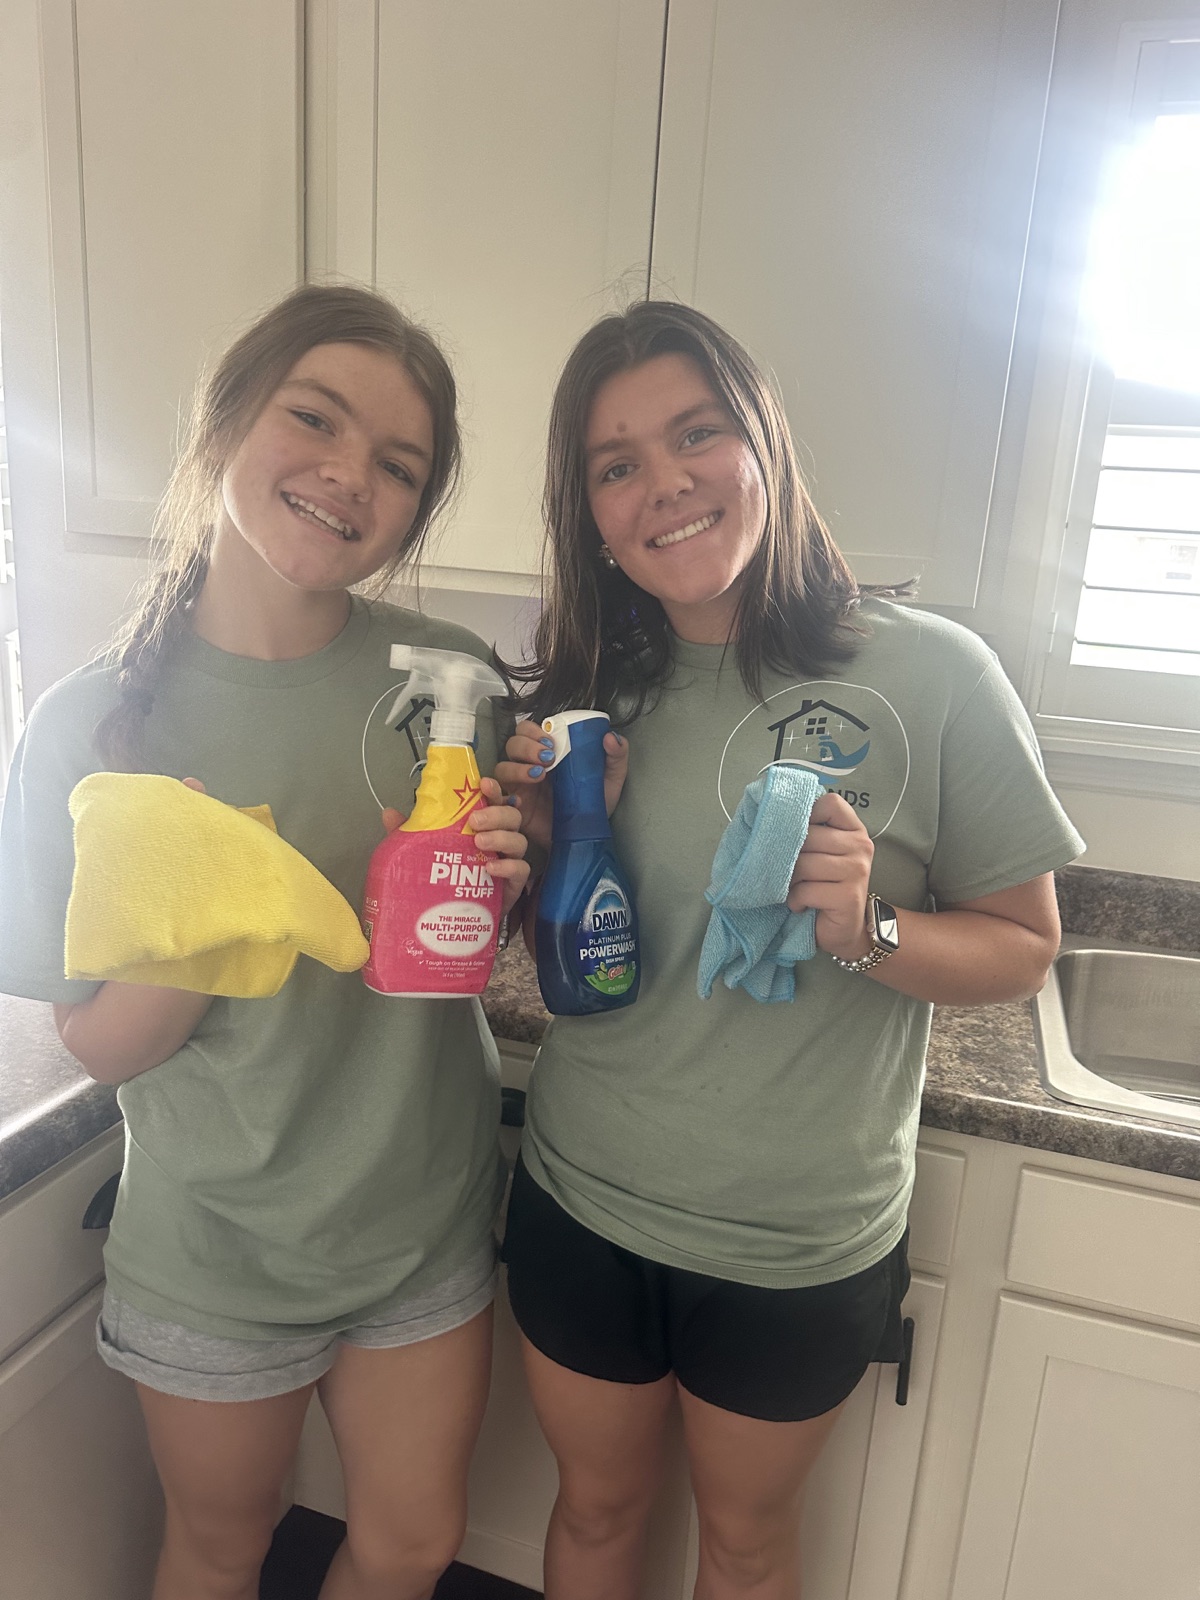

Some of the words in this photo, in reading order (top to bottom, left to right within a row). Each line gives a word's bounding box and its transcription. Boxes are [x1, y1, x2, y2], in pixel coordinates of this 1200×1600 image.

[434, 851, 462, 864] THE
[430, 862, 495, 887] PINK
[455, 887, 494, 898] STUFF
[592, 909, 629, 932] DAWN
[420, 922, 491, 933] MULTI-PURPOSE
[436, 933, 479, 942] CLEANER
[589, 934, 620, 945] PLATINUM
[621, 932, 631, 940] PLUS
[580, 940, 636, 961] POWERWASH
